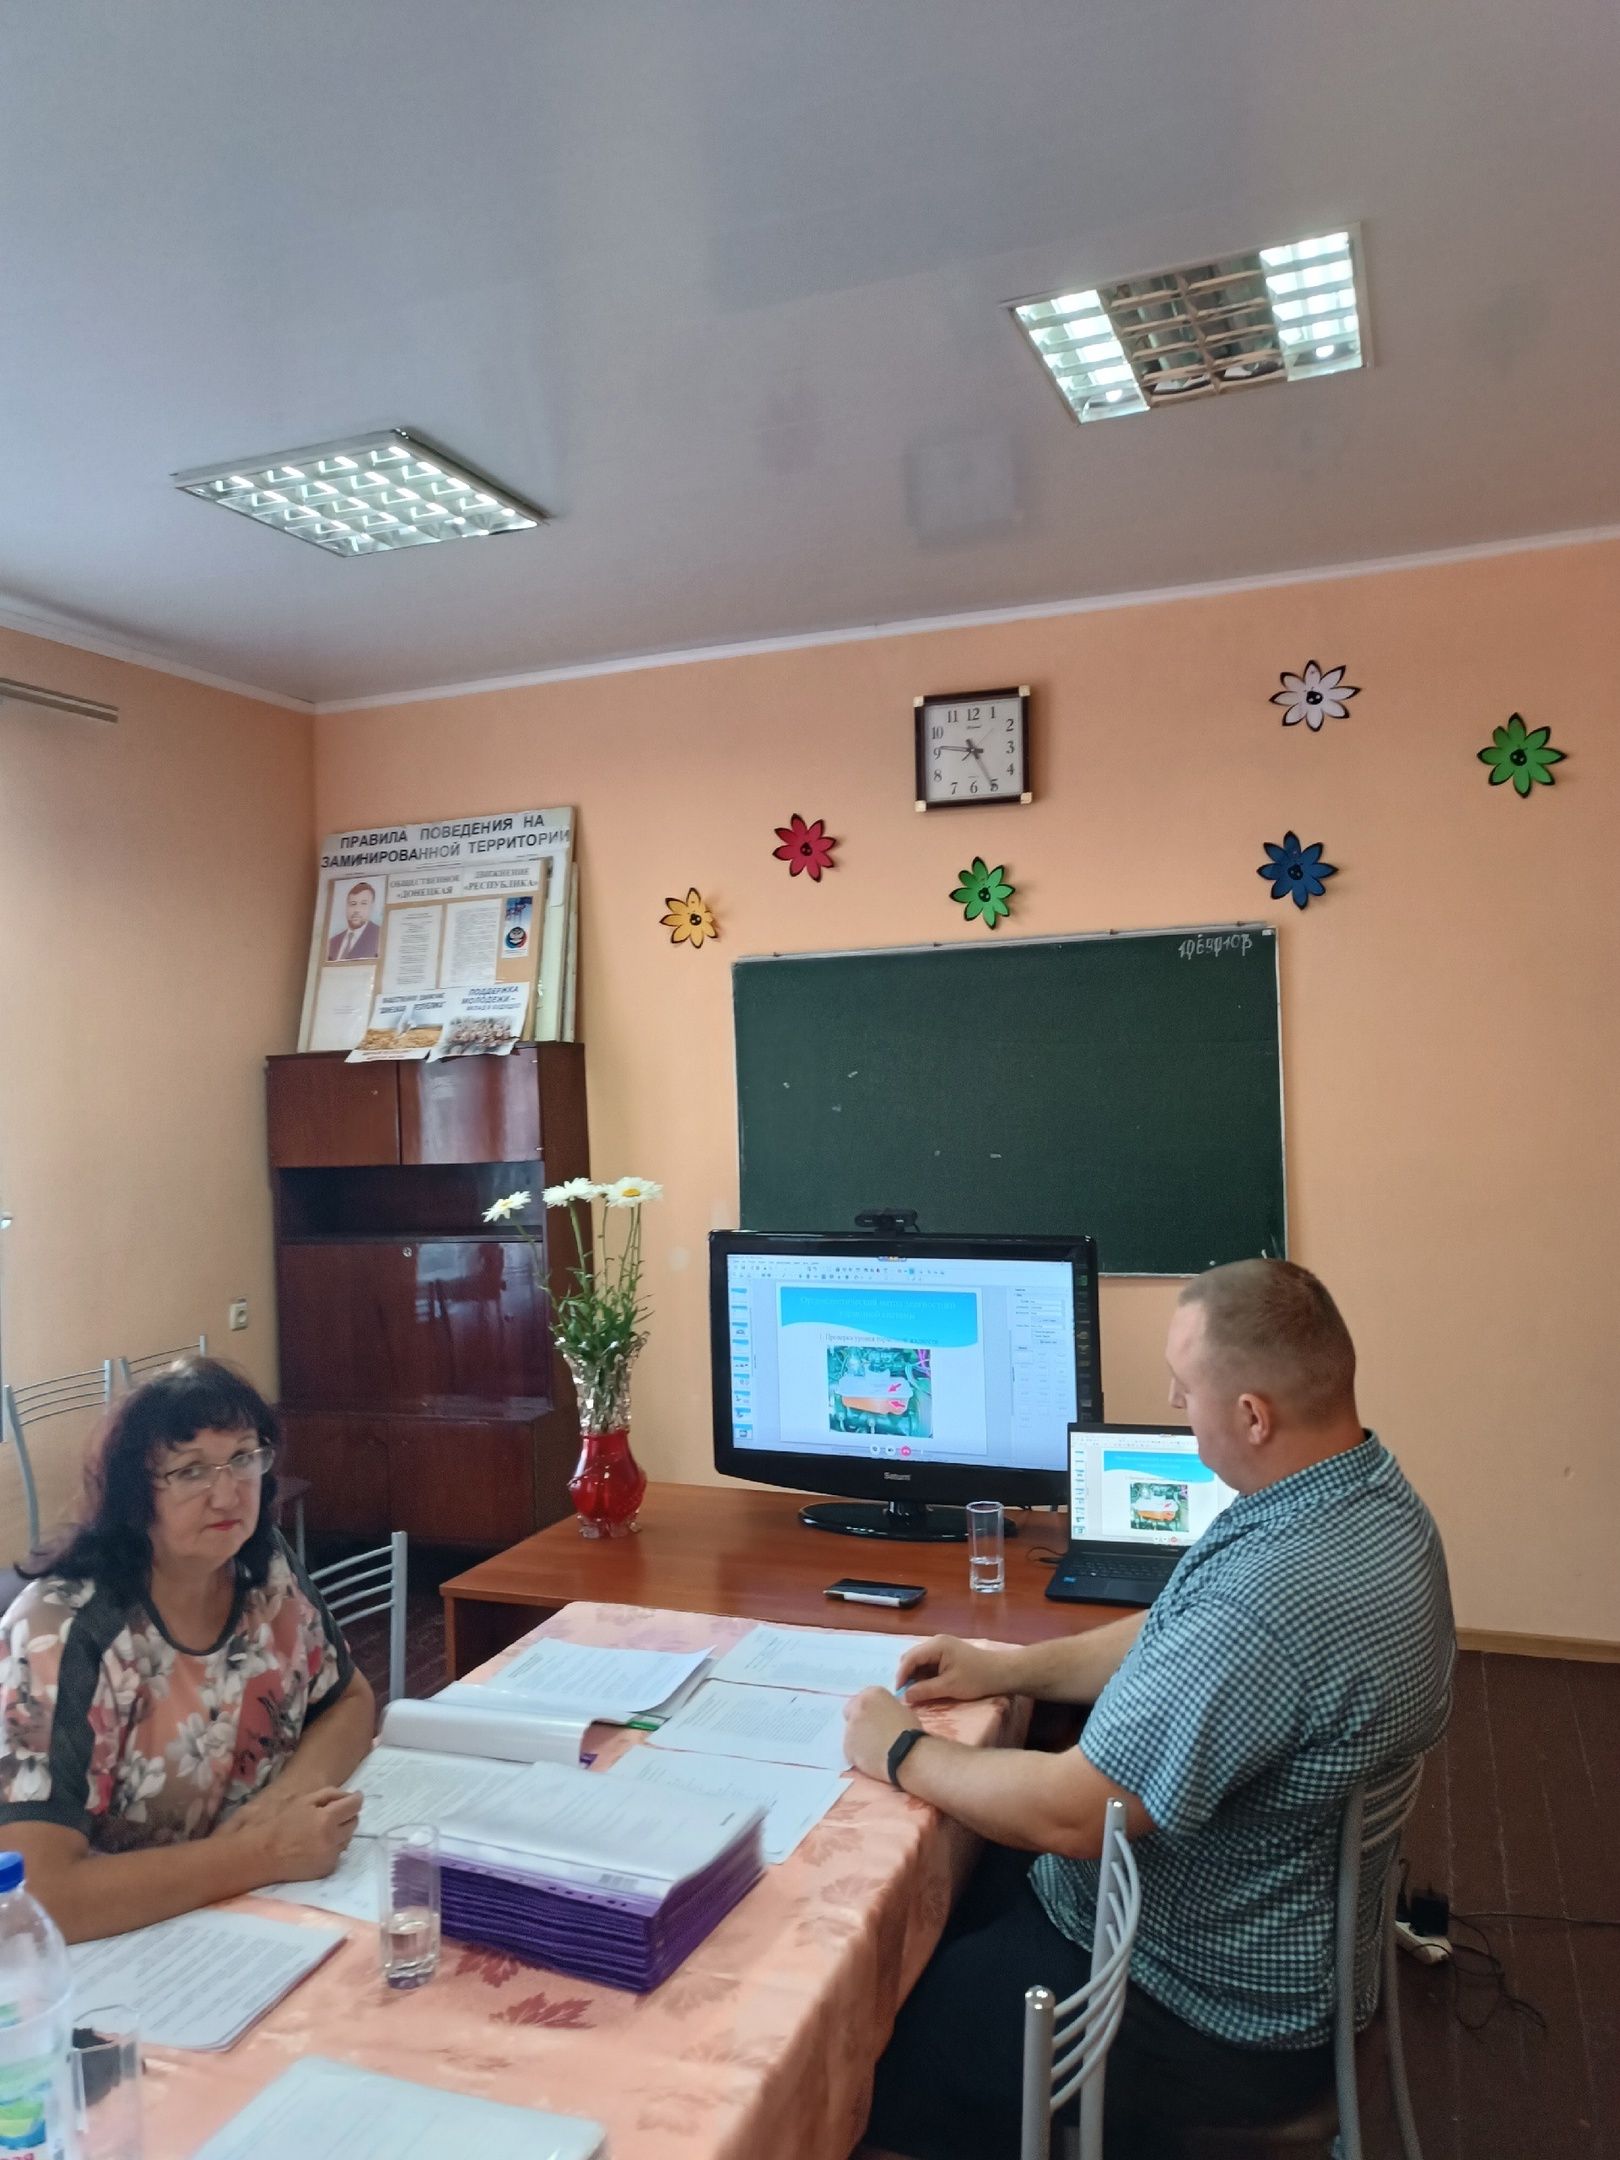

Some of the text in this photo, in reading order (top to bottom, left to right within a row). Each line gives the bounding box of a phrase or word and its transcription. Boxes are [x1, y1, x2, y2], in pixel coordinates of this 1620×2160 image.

[947, 709, 958, 723] 11
[967, 707, 980, 721] 12
[990, 706, 996, 719] 1
[1005, 718, 1014, 732] 2
[931, 726, 944, 740] 10
[933, 747, 942, 761] 9
[1005, 740, 1015, 754] 3
[933, 769, 943, 782] 8
[1005, 763, 1015, 776] 4
[950, 782, 958, 795] 7
[969, 780, 978, 794] 6
[990, 778, 999, 792] 5
[340, 814, 545, 849] ПРАВИЛА ПОВЕДЕНИЯ НА
[320, 829, 570, 868] ЗАМИНИРОВАННОЙ ТЕРРИТОРИИ
[467, 986, 519, 996] ПОДДЕРЖКА
